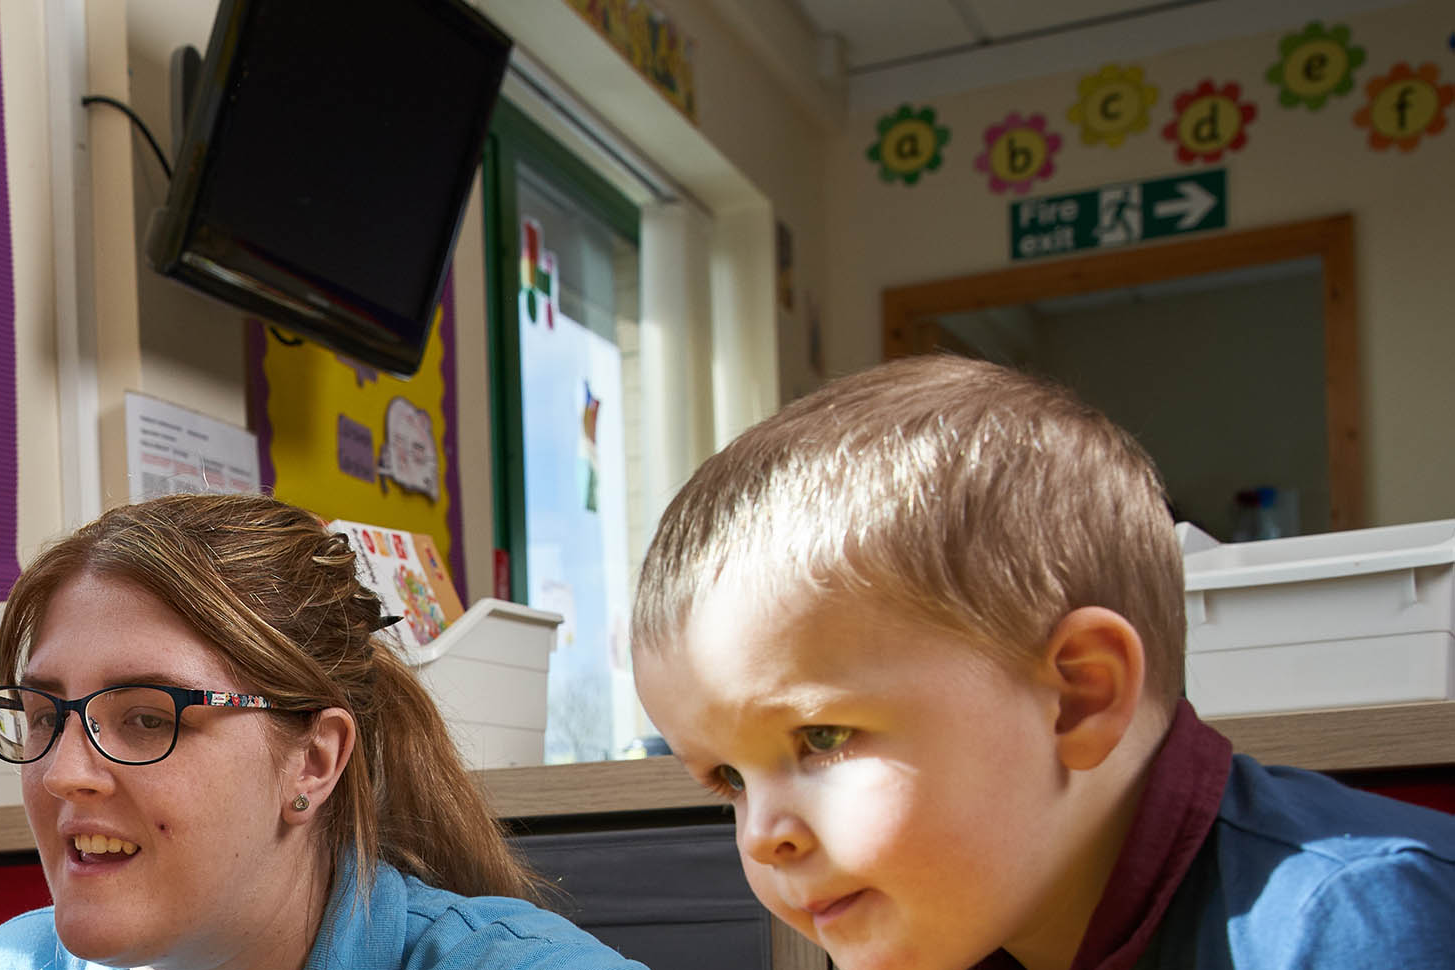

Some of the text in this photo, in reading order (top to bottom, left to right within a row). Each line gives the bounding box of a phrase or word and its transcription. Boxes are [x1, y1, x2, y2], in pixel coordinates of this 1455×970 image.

[1304, 52, 1327, 81] e
[1100, 92, 1121, 121] c
[1395, 87, 1414, 130] f
[1193, 105, 1220, 144] d
[896, 131, 920, 162] a
[1007, 137, 1032, 174] b
[1019, 199, 1079, 228] Fire
[1019, 228, 1075, 256] exit
